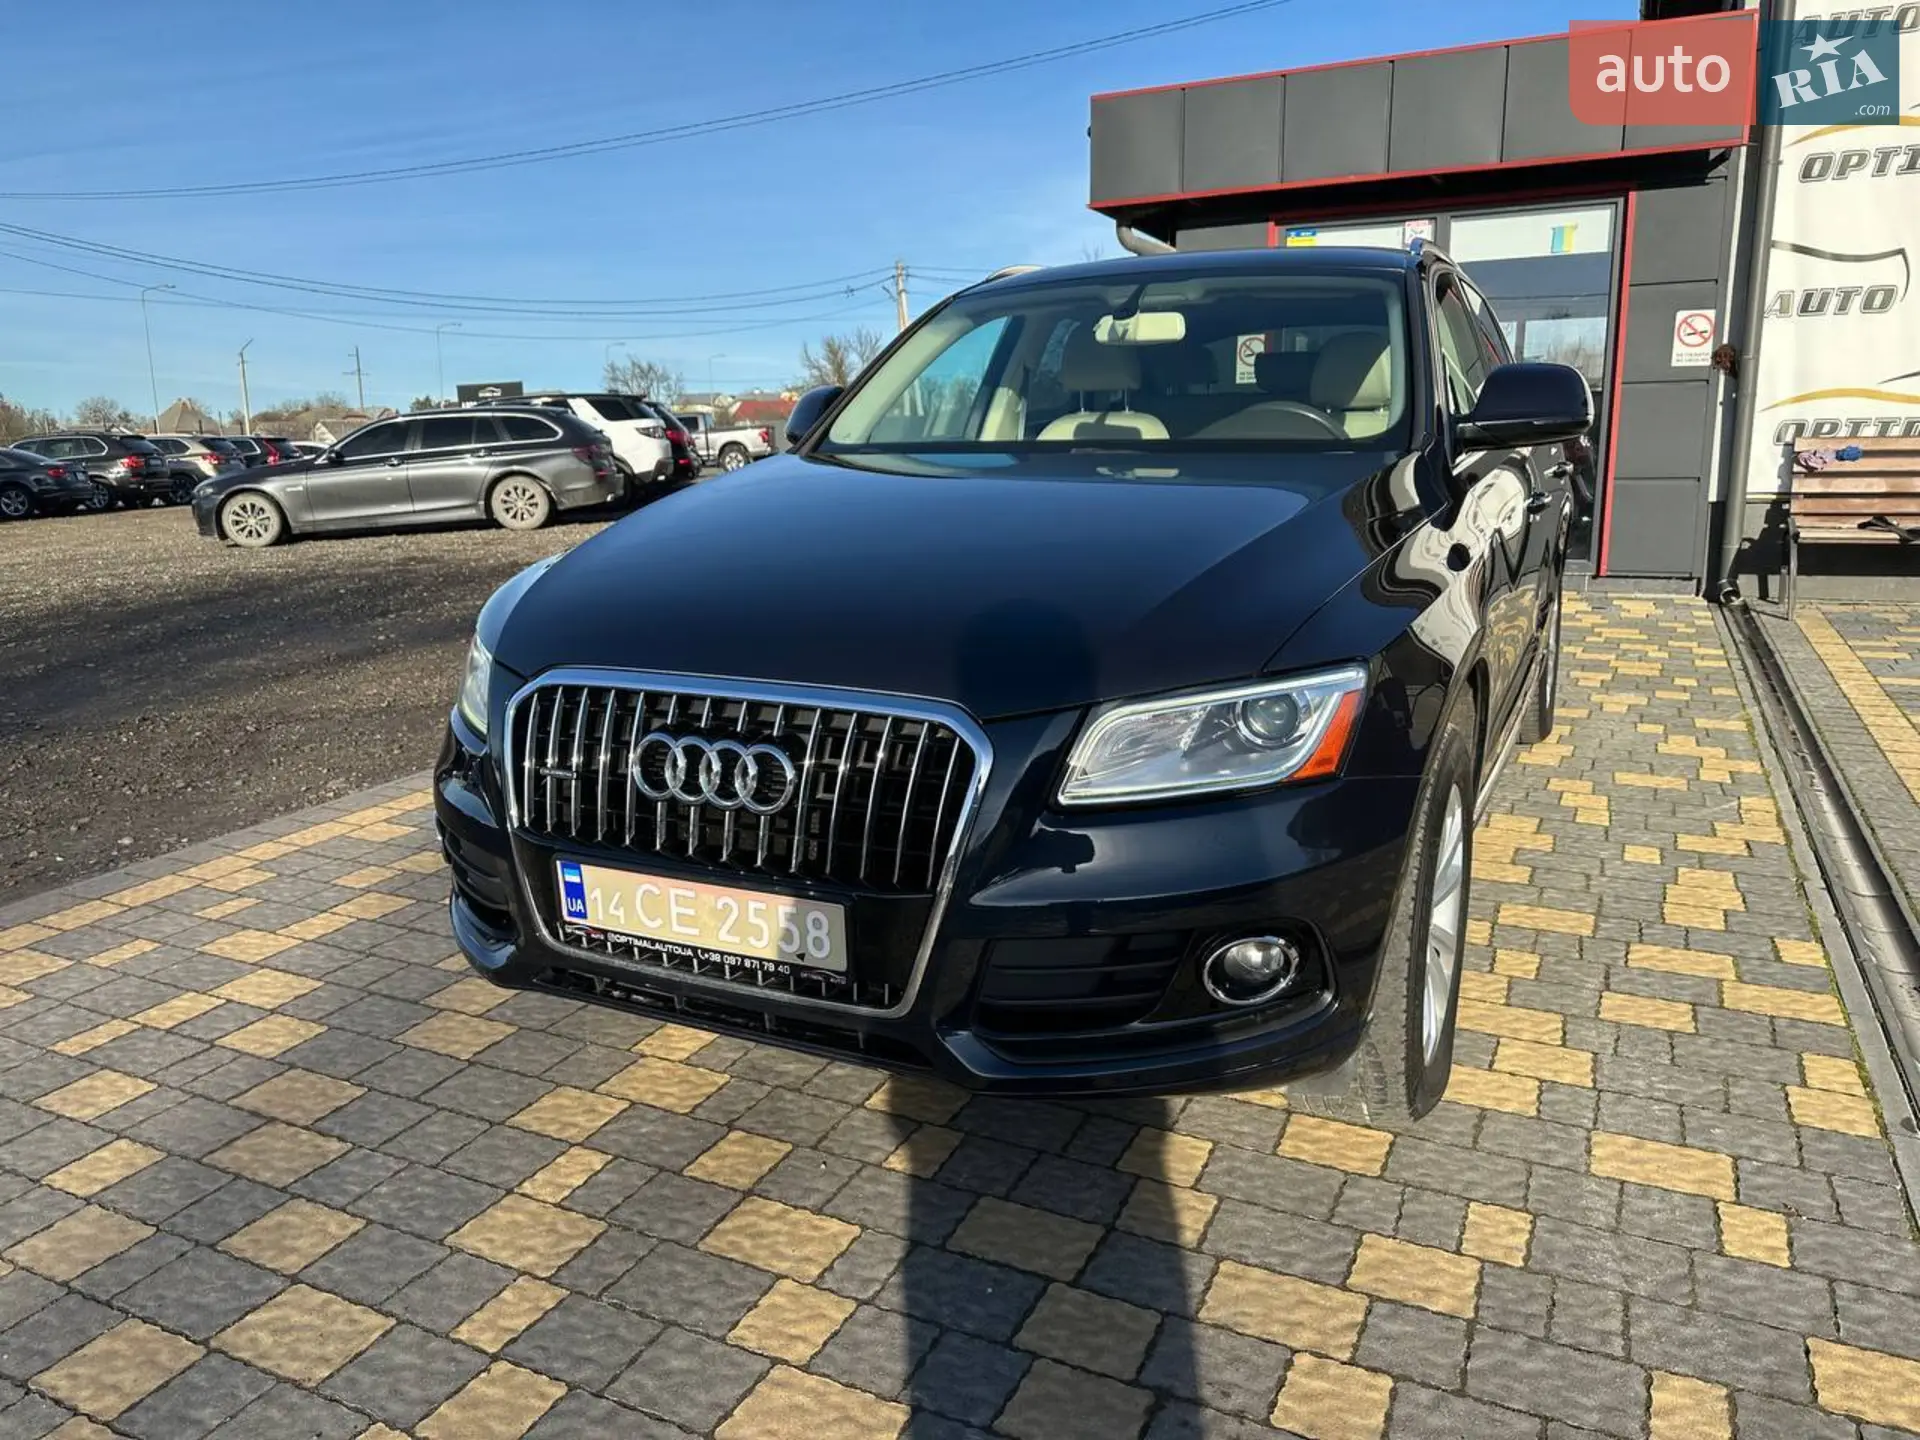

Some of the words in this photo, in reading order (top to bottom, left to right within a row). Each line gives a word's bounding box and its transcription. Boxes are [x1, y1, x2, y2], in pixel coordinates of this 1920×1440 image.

[1764, 285, 1898, 319] AUTO
[568, 898, 585, 913] UA
[590, 887, 625, 924] 14
[635, 883, 700, 936] CE
[716, 895, 831, 958] 2558
